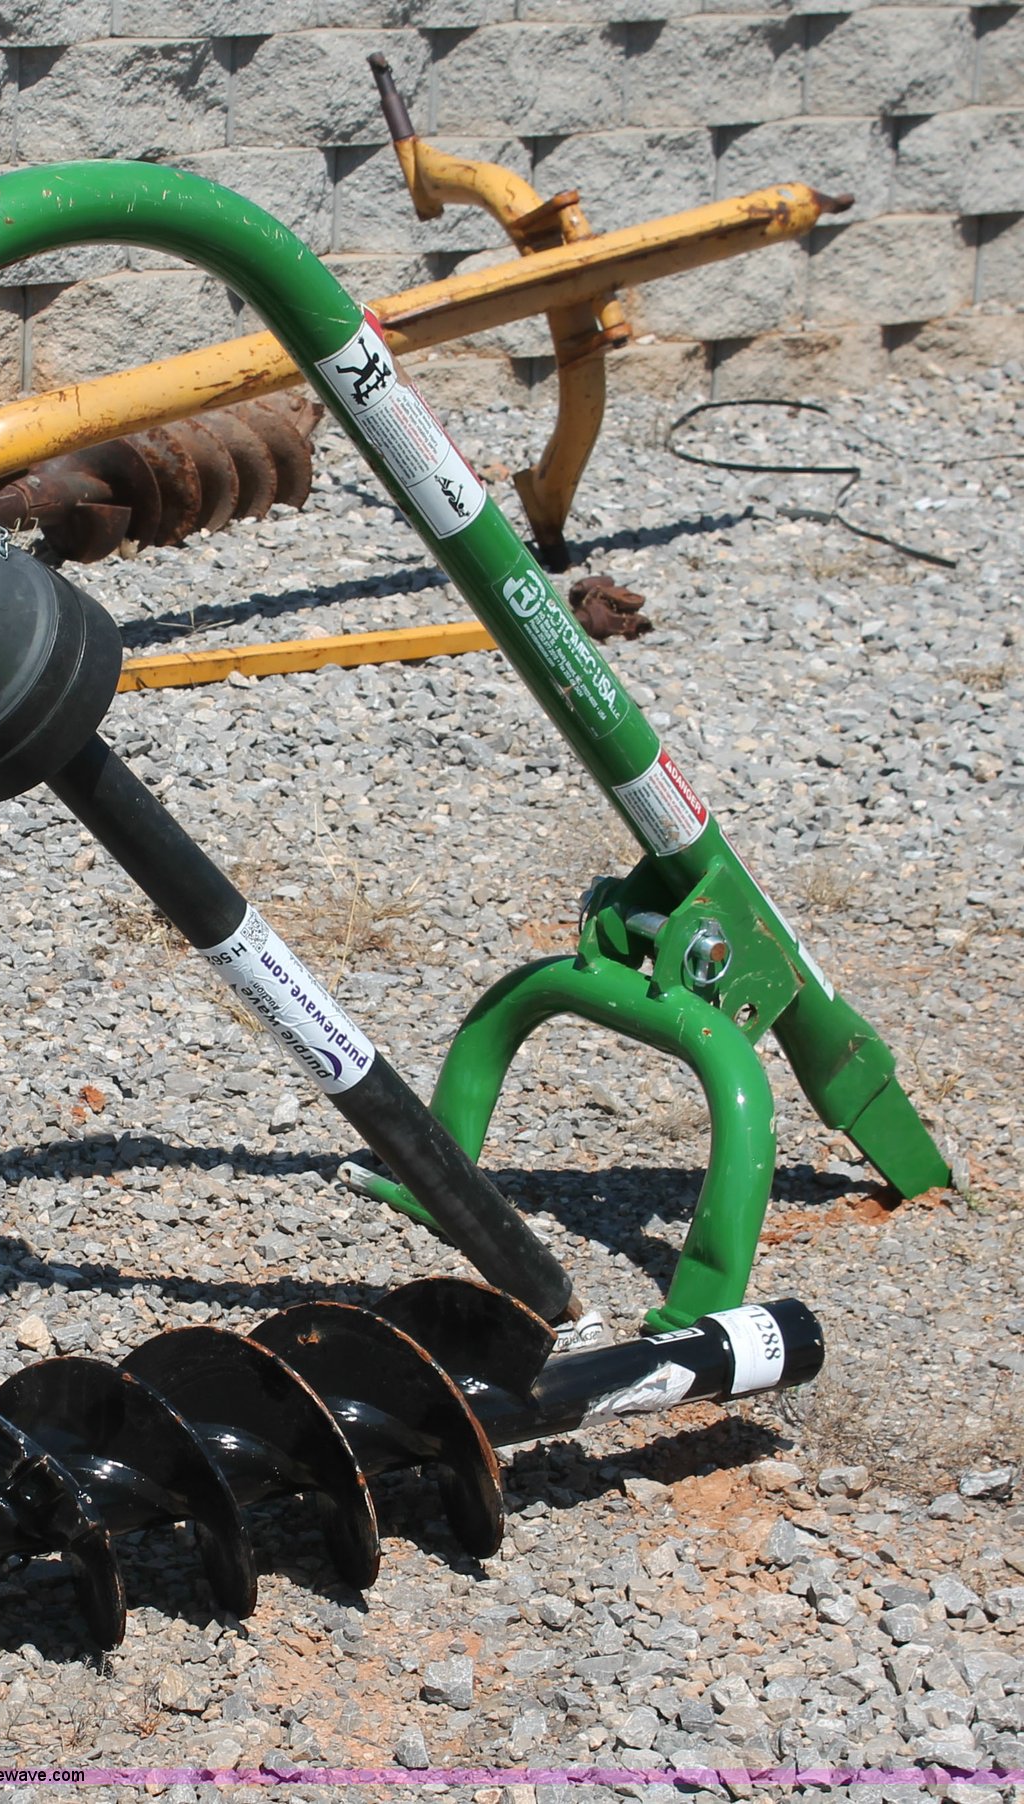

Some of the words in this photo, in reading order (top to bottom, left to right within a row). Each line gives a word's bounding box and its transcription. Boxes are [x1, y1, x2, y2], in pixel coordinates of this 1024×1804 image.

[592, 667, 620, 709] USA
[671, 769, 702, 814] DANGER
[231, 943, 247, 957] H
[241, 986, 280, 1027] wave
[252, 982, 280, 1010] auction
[260, 951, 368, 1070] purplewave.com
[281, 1030, 333, 1079] purple
